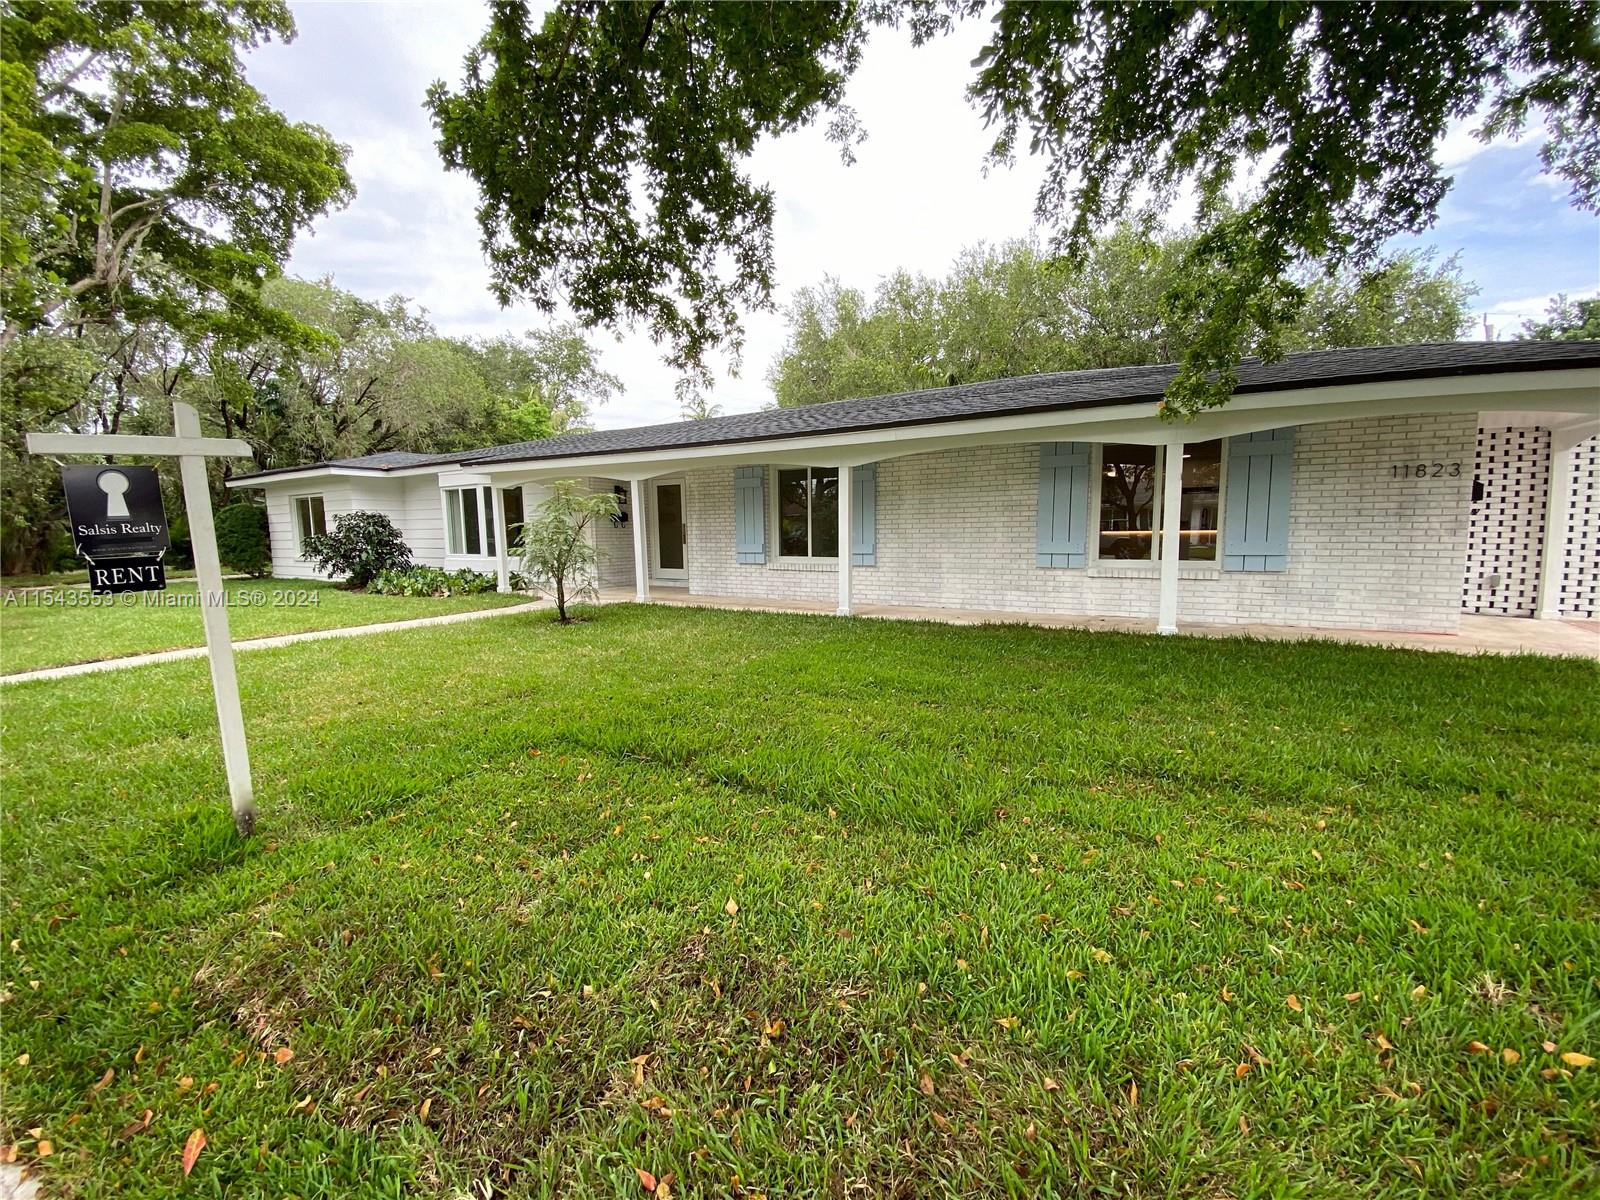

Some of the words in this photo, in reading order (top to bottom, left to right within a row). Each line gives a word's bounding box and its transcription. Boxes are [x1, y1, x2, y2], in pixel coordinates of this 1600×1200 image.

[1392, 462, 1461, 479] 11823
[78, 523, 118, 536] Salsis
[120, 522, 162, 535] Realty
[94, 565, 160, 586] RENT
